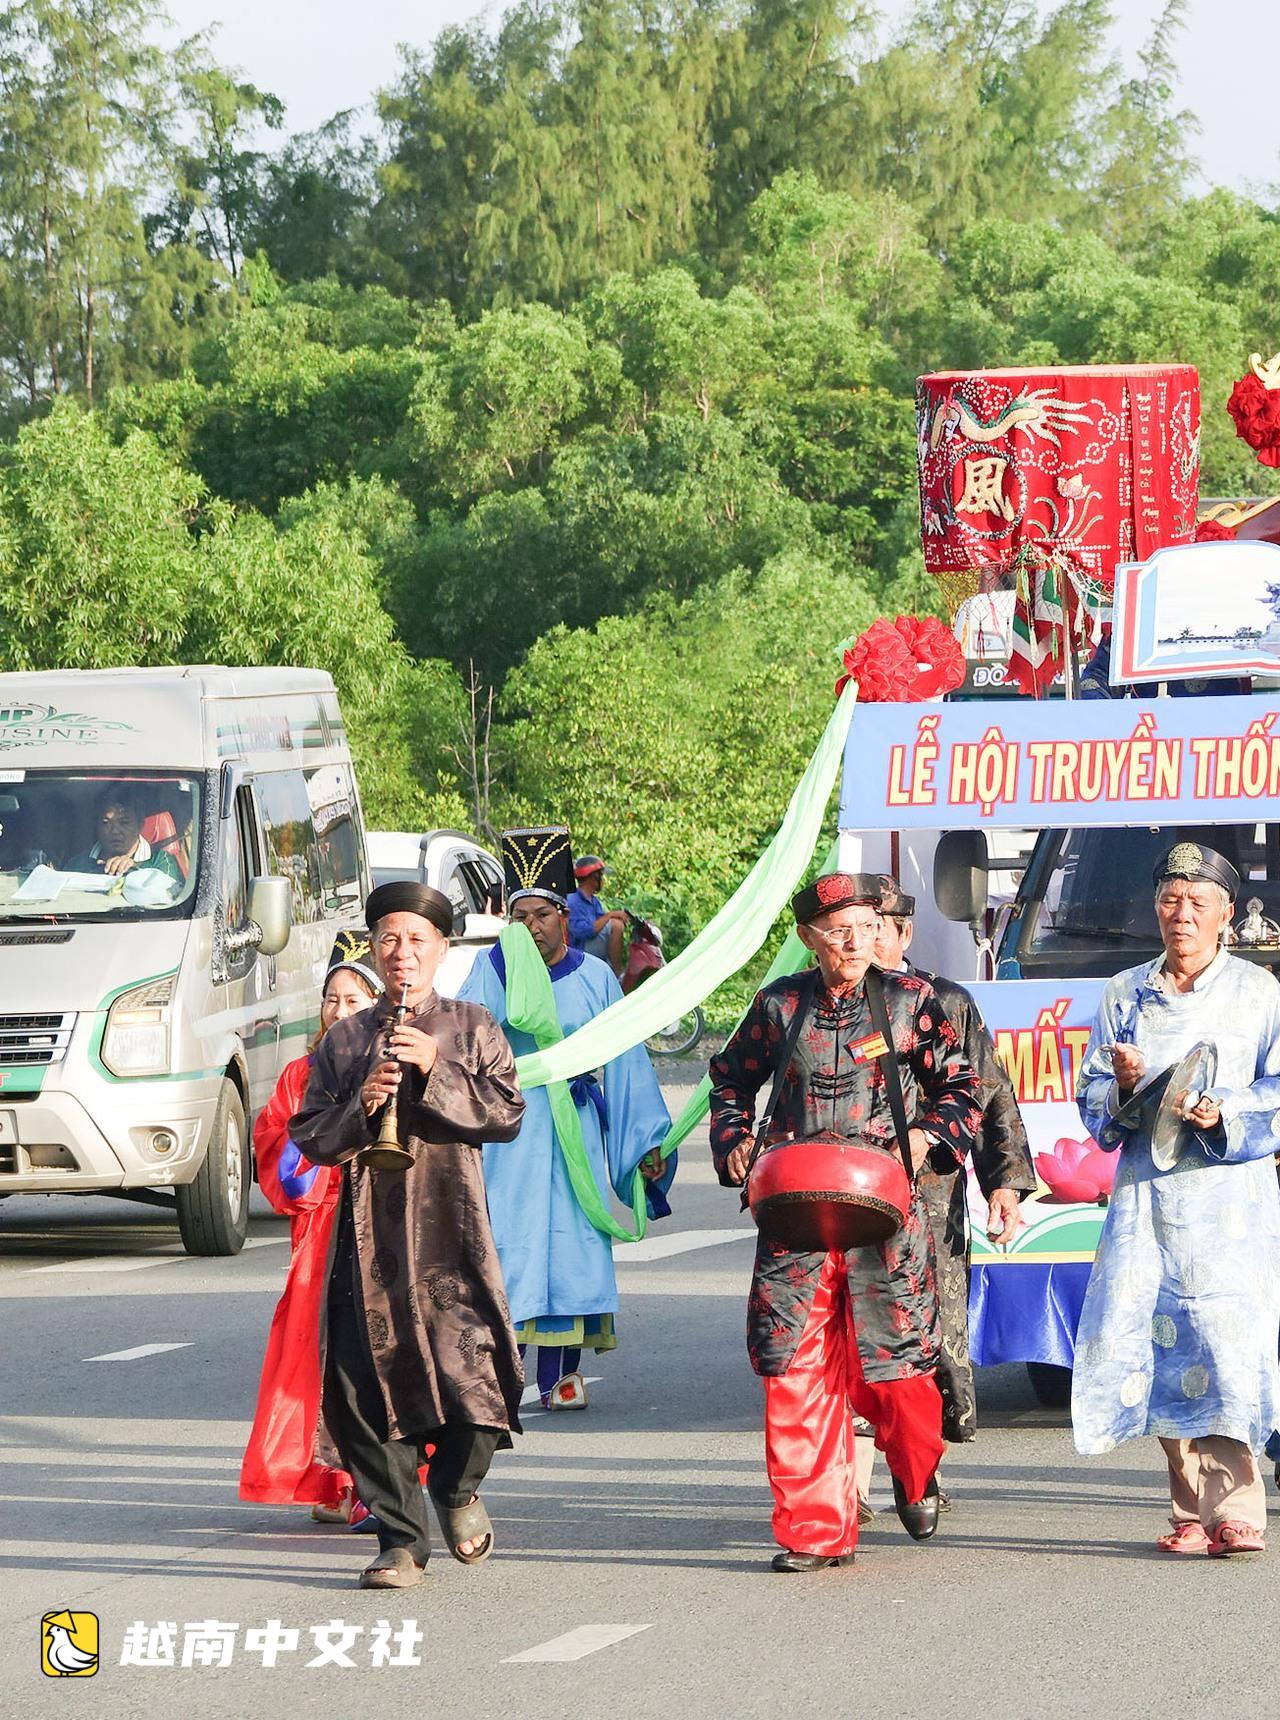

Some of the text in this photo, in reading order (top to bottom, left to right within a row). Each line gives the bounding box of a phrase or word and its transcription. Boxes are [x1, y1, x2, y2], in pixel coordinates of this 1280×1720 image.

[0, 709, 34, 721] IP
[886, 714, 942, 807] LỄ
[947, 726, 1020, 817] HỘI
[1027, 713, 1184, 803] TRUYỀN
[995, 998, 1091, 1104] MẤT
